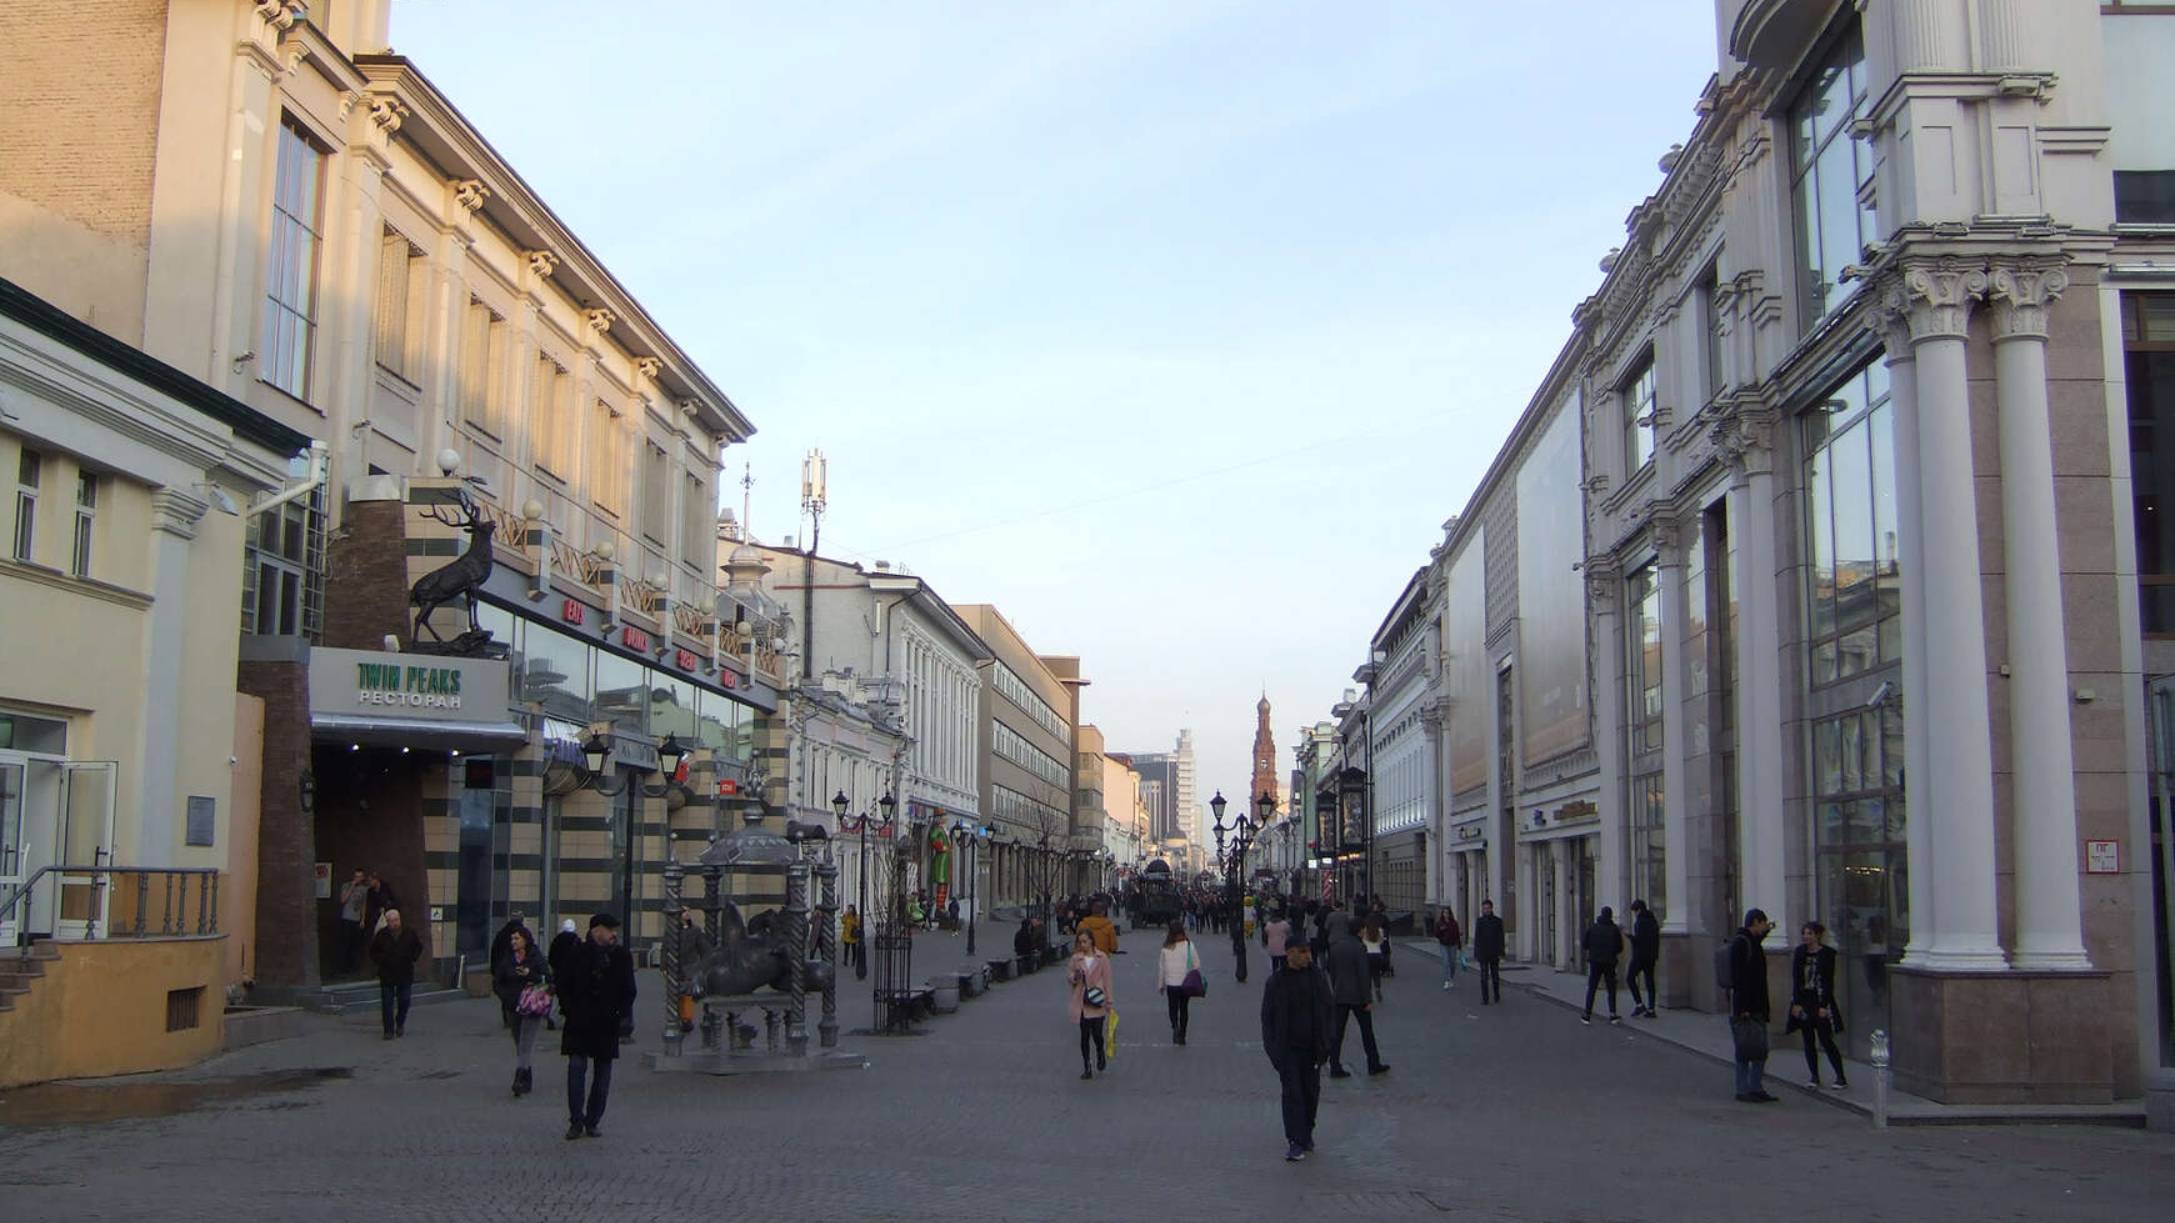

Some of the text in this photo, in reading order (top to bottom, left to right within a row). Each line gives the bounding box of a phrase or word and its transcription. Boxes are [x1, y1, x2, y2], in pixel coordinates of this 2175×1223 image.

[357, 663, 461, 695] TWIN PEAKS
[360, 691, 461, 709] РЕСТОРАН
